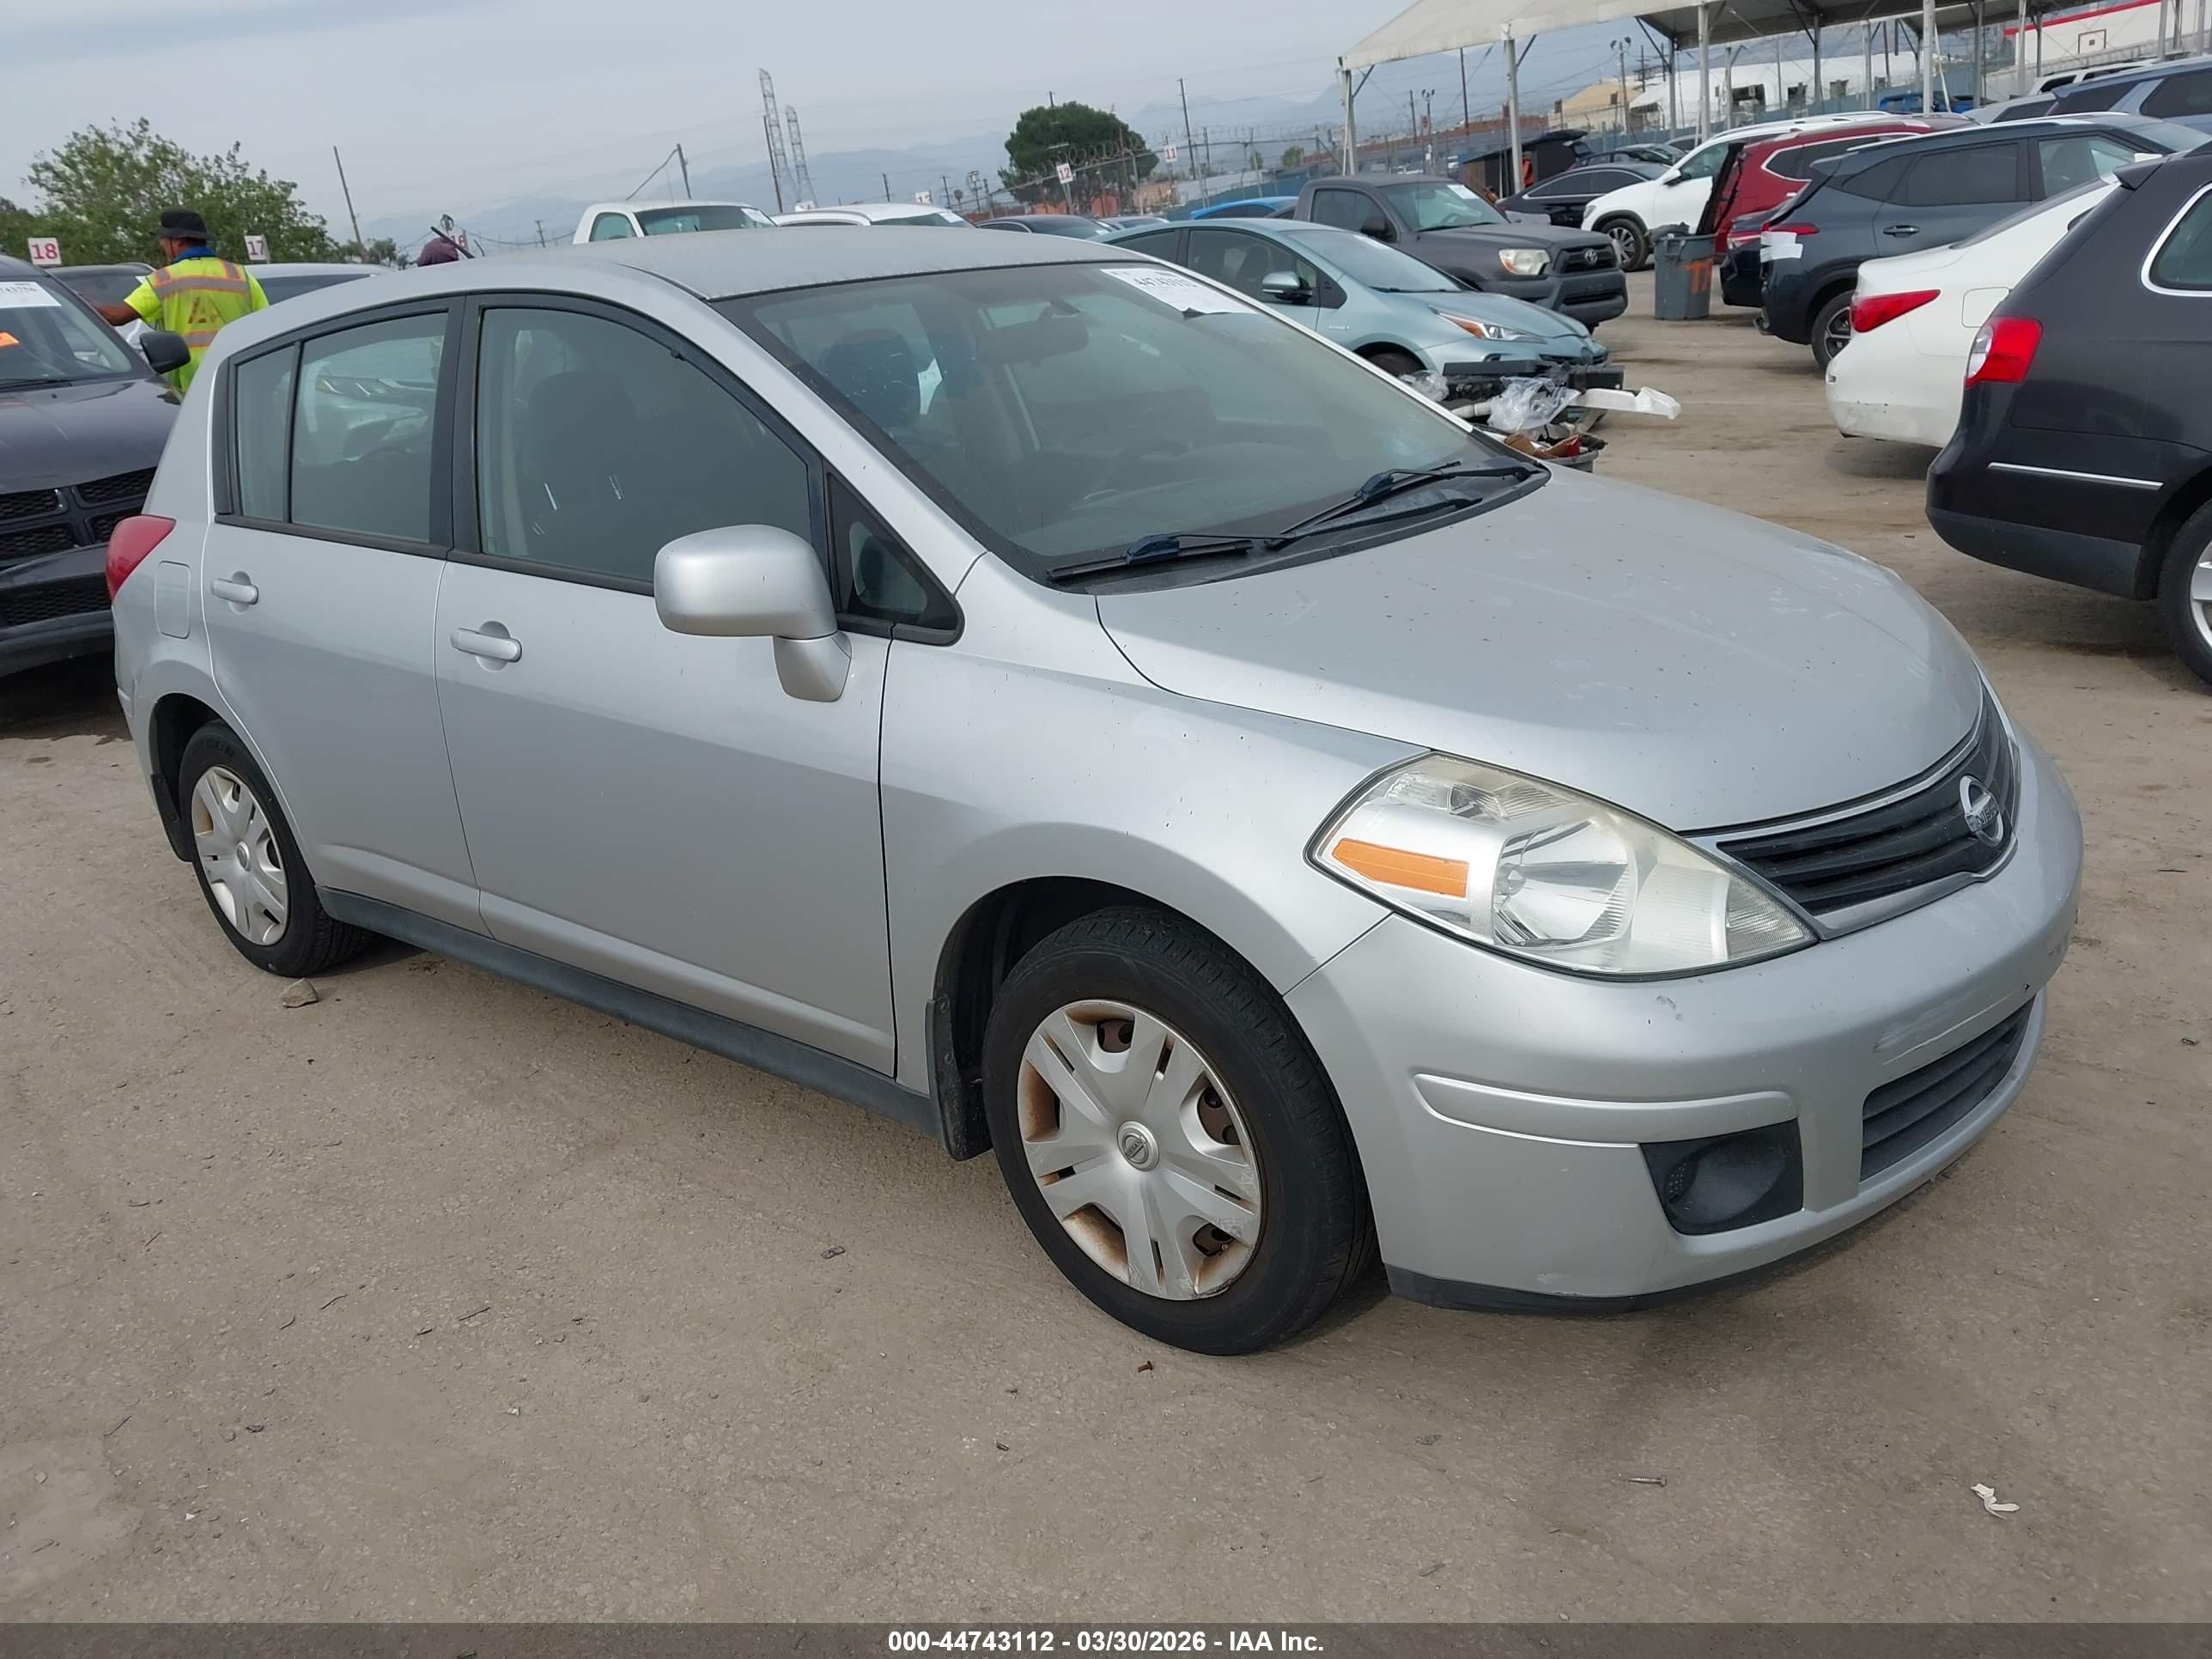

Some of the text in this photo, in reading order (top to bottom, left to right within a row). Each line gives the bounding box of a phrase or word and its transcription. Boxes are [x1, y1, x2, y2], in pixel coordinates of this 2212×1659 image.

[1060, 167, 1071, 180] 12
[31, 243, 58, 259] 18
[247, 240, 264, 256] 17
